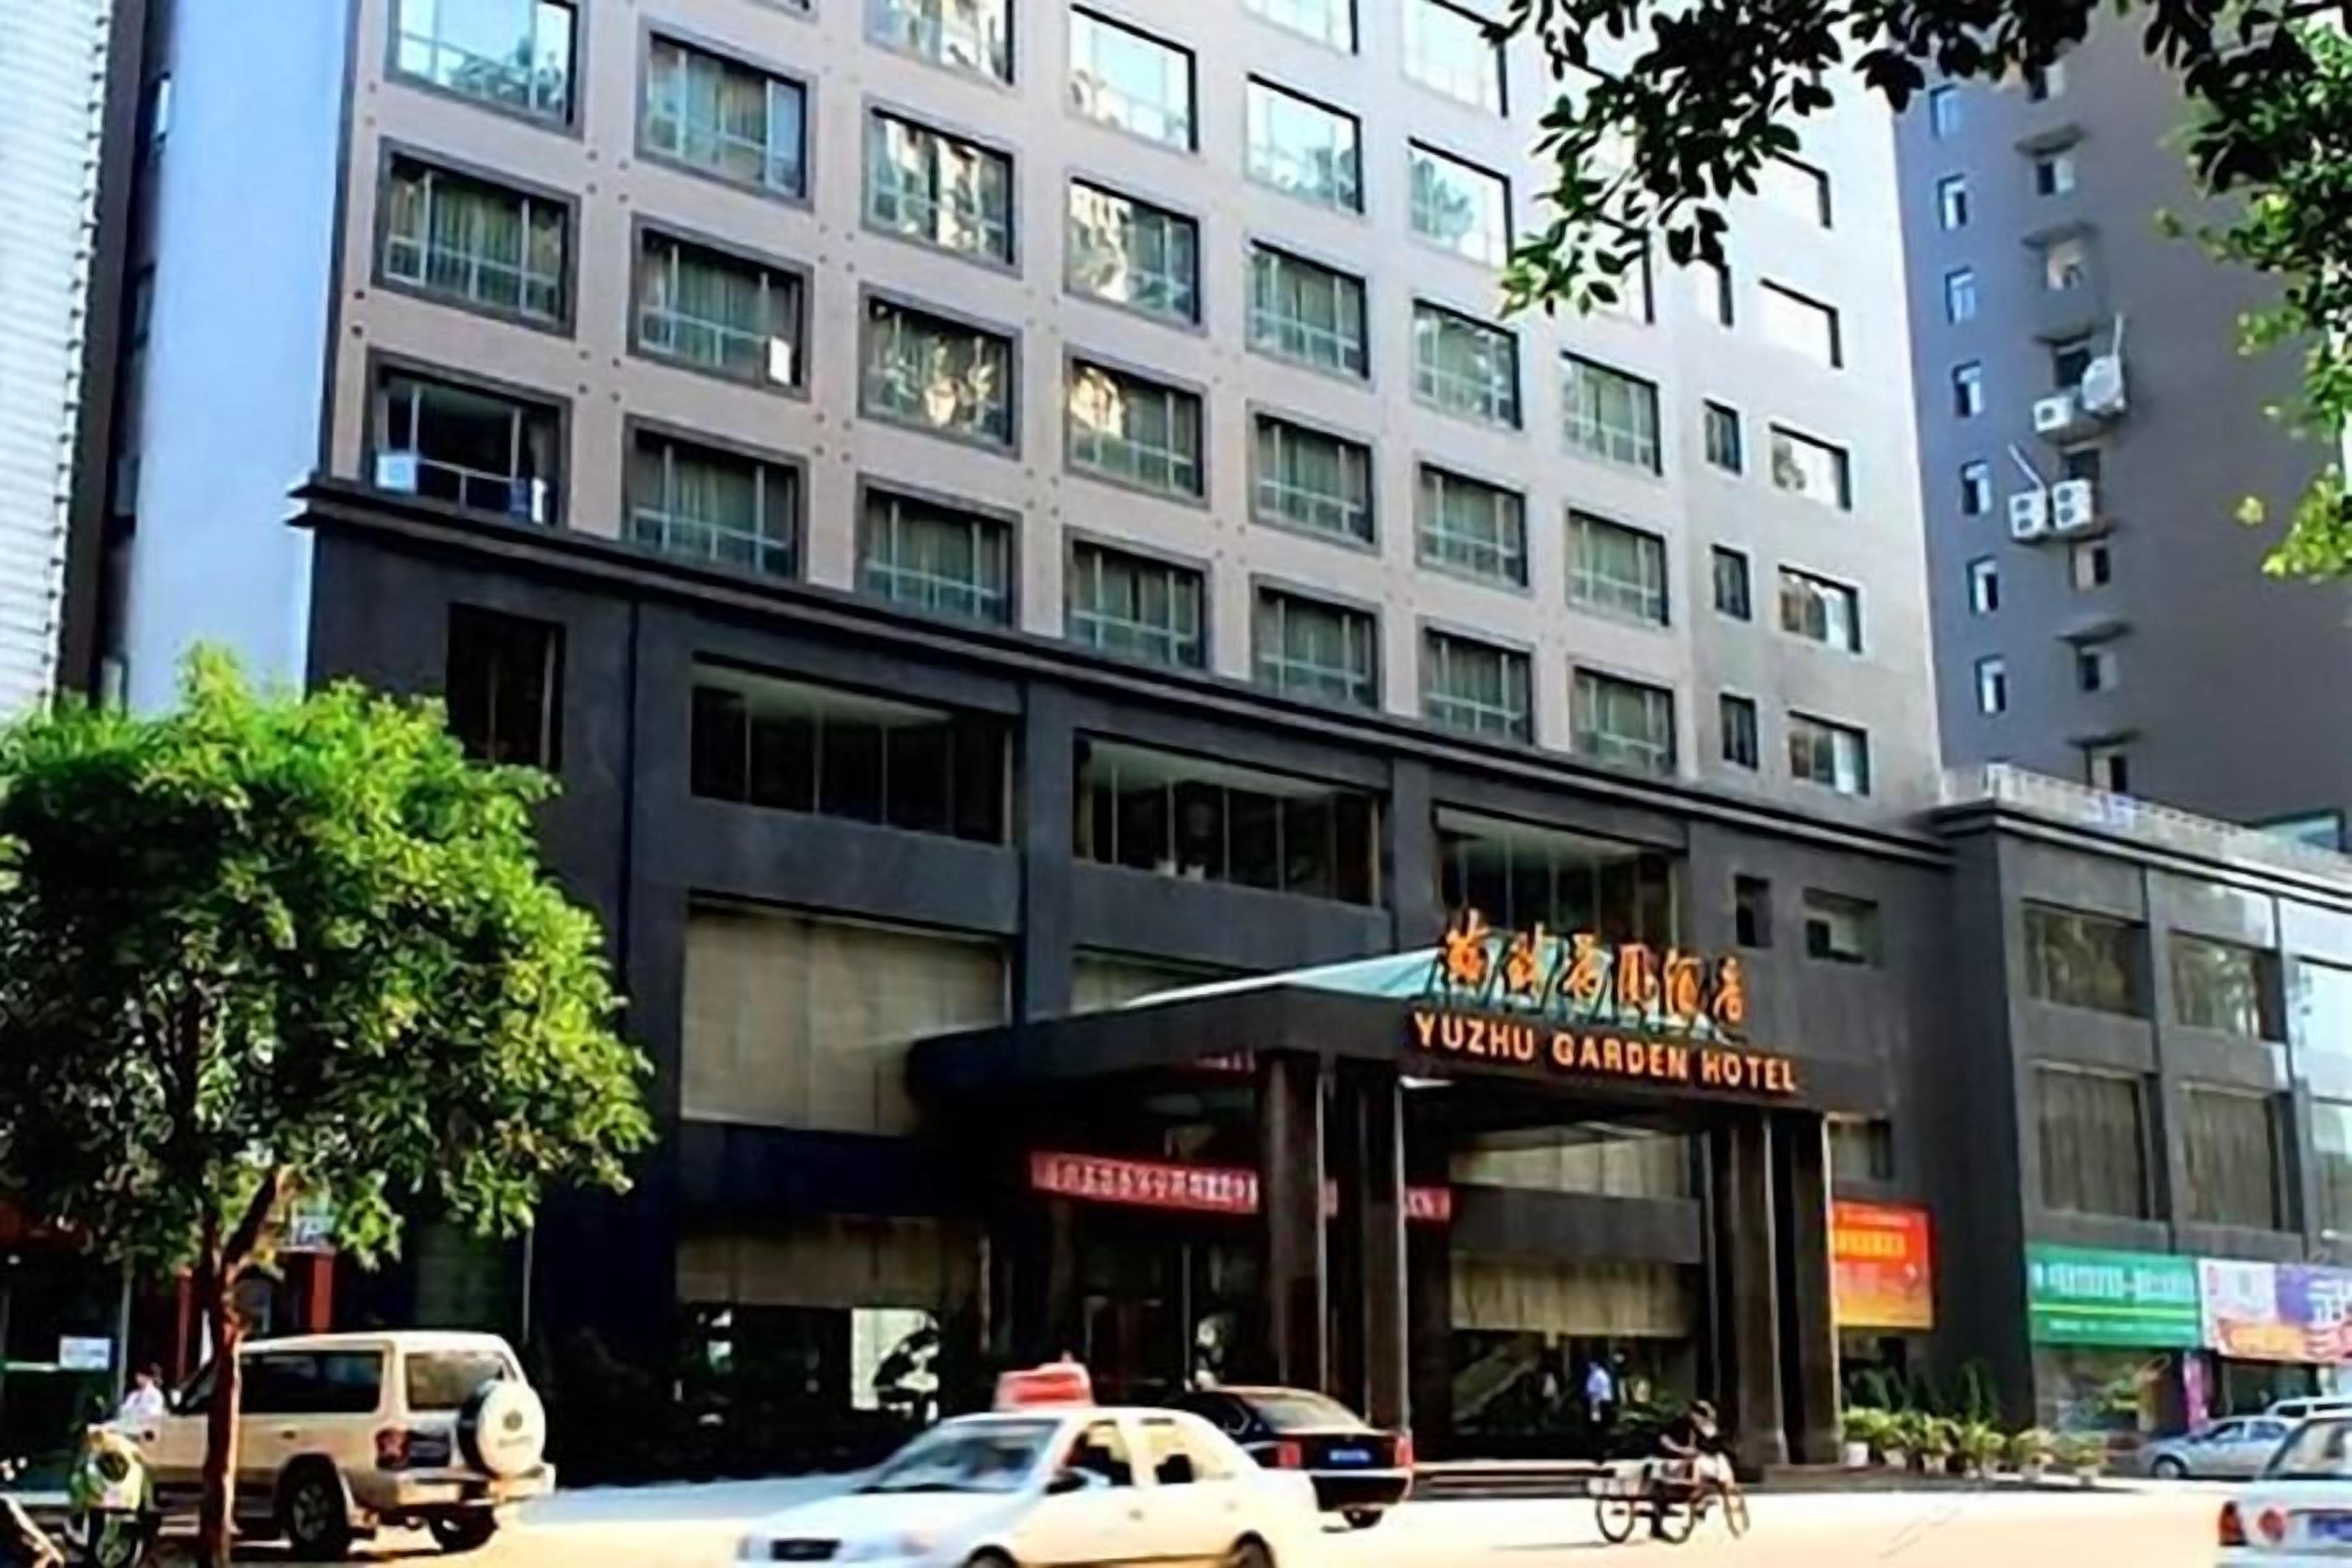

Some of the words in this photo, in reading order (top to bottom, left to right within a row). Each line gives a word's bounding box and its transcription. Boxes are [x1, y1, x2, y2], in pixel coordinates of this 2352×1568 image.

[1414, 1011, 1535, 1060] YUZHU
[1552, 1032, 1689, 1080] GARDEN
[1700, 1051, 1797, 1092] HOTEL
